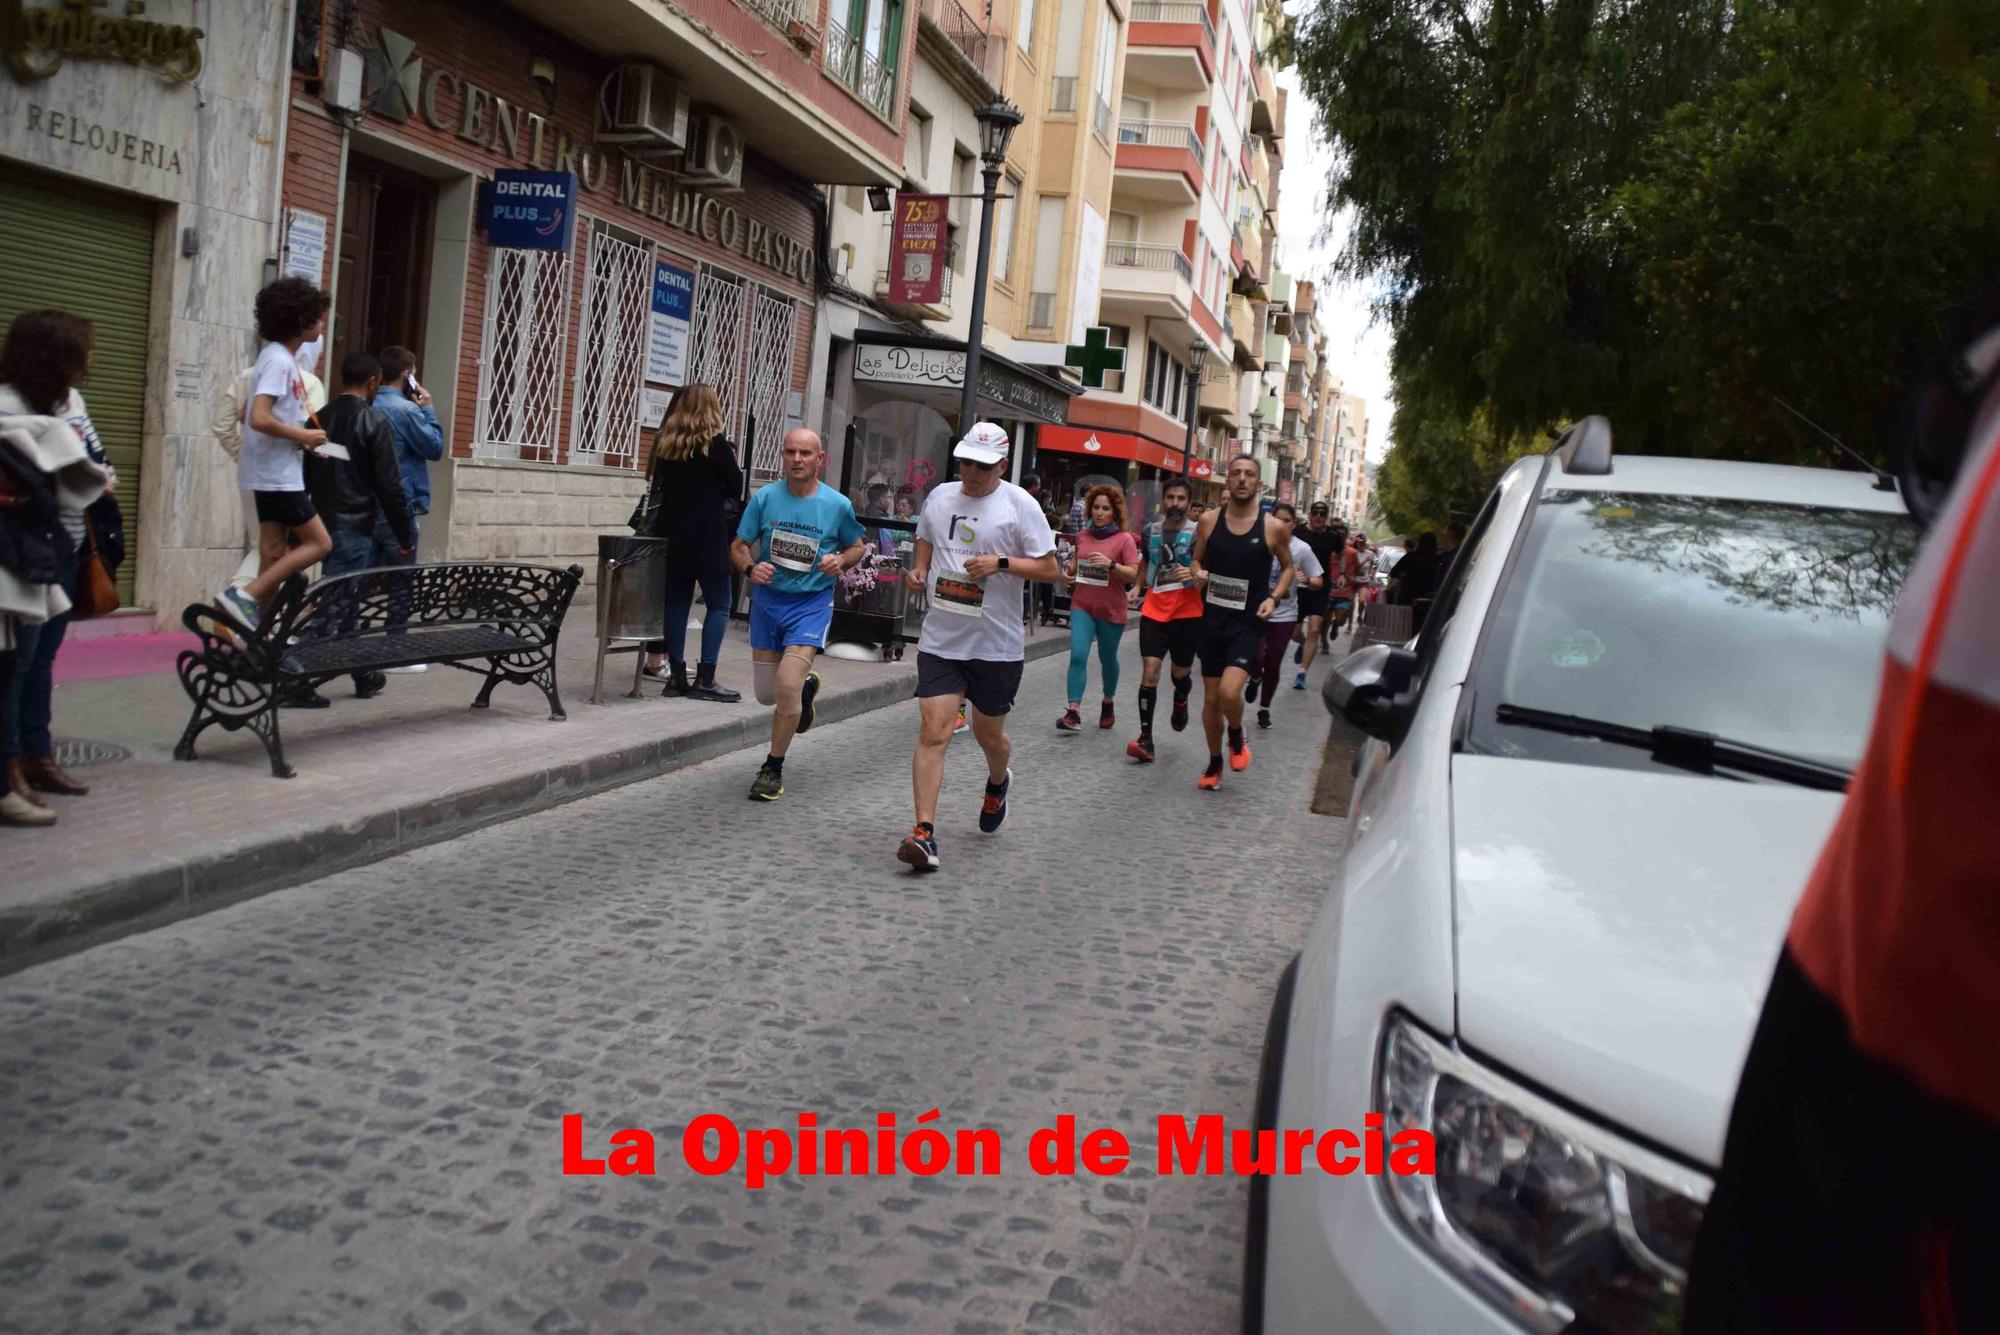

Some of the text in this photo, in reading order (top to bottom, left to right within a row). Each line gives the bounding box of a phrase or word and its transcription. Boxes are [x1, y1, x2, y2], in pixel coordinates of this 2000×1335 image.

[27, 103, 182, 174] RELOJERIA
[424, 69, 815, 283] CENTRO MEDICO PASEO
[496, 181, 566, 198] DENTAL
[493, 205, 539, 220] PLUS
[658, 269, 691, 292] DENTAL
[656, 290, 680, 307] PLUS
[857, 347, 966, 376] Las Delicias
[778, 540, 812, 556] 1268
